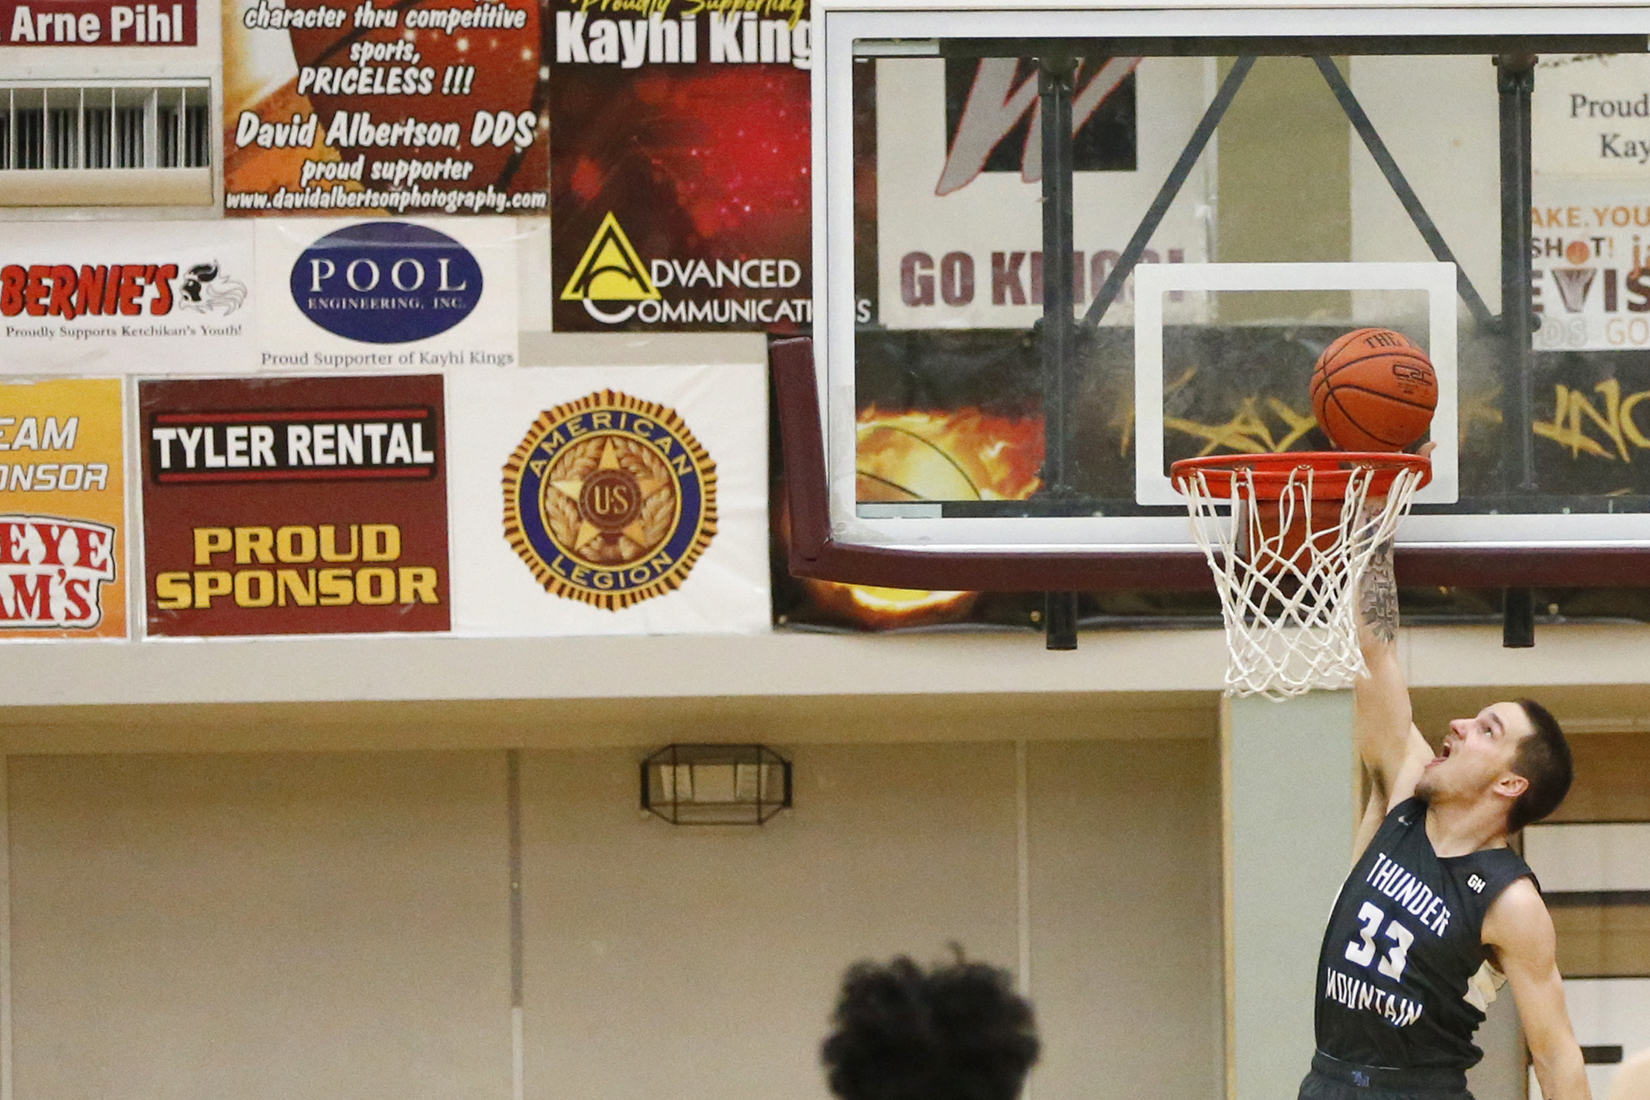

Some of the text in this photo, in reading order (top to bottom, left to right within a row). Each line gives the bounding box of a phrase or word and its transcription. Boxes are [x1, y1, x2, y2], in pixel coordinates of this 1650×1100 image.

[10, 5, 183, 43] Arne Pihl
[244, 0, 527, 34] character thru competitive
[350, 39, 421, 65] sports,
[555, 11, 812, 70] Kayhi King
[297, 67, 475, 96] PRICELESS !!!
[1570, 93, 1650, 118] Proud
[235, 110, 535, 149] David Albertson DDS
[302, 158, 473, 182] proud supporter
[225, 187, 547, 214] www.davidalbertsonphotography.com
[1, 264, 179, 320] BERNIE'S
[310, 259, 467, 292] POOL
[900, 249, 975, 307] GO
[6, 325, 242, 340] Proudly Supports Ketchikan's Youth!
[1605, 318, 1649, 345] GO
[261, 351, 514, 368] Proud Supporter of Kayhi Kings
[152, 422, 434, 469] TYLER RENTAL
[529, 411, 693, 478] AMERICAN
[193, 524, 402, 565] PROUD
[155, 568, 439, 609] SPONSOR
[551, 552, 674, 591] LEGION
[1366, 852, 1451, 937] THUNDER
[1467, 874, 1486, 893] GH
[1345, 901, 1415, 982] 33
[1325, 966, 1423, 1027] MOUNTAIN
